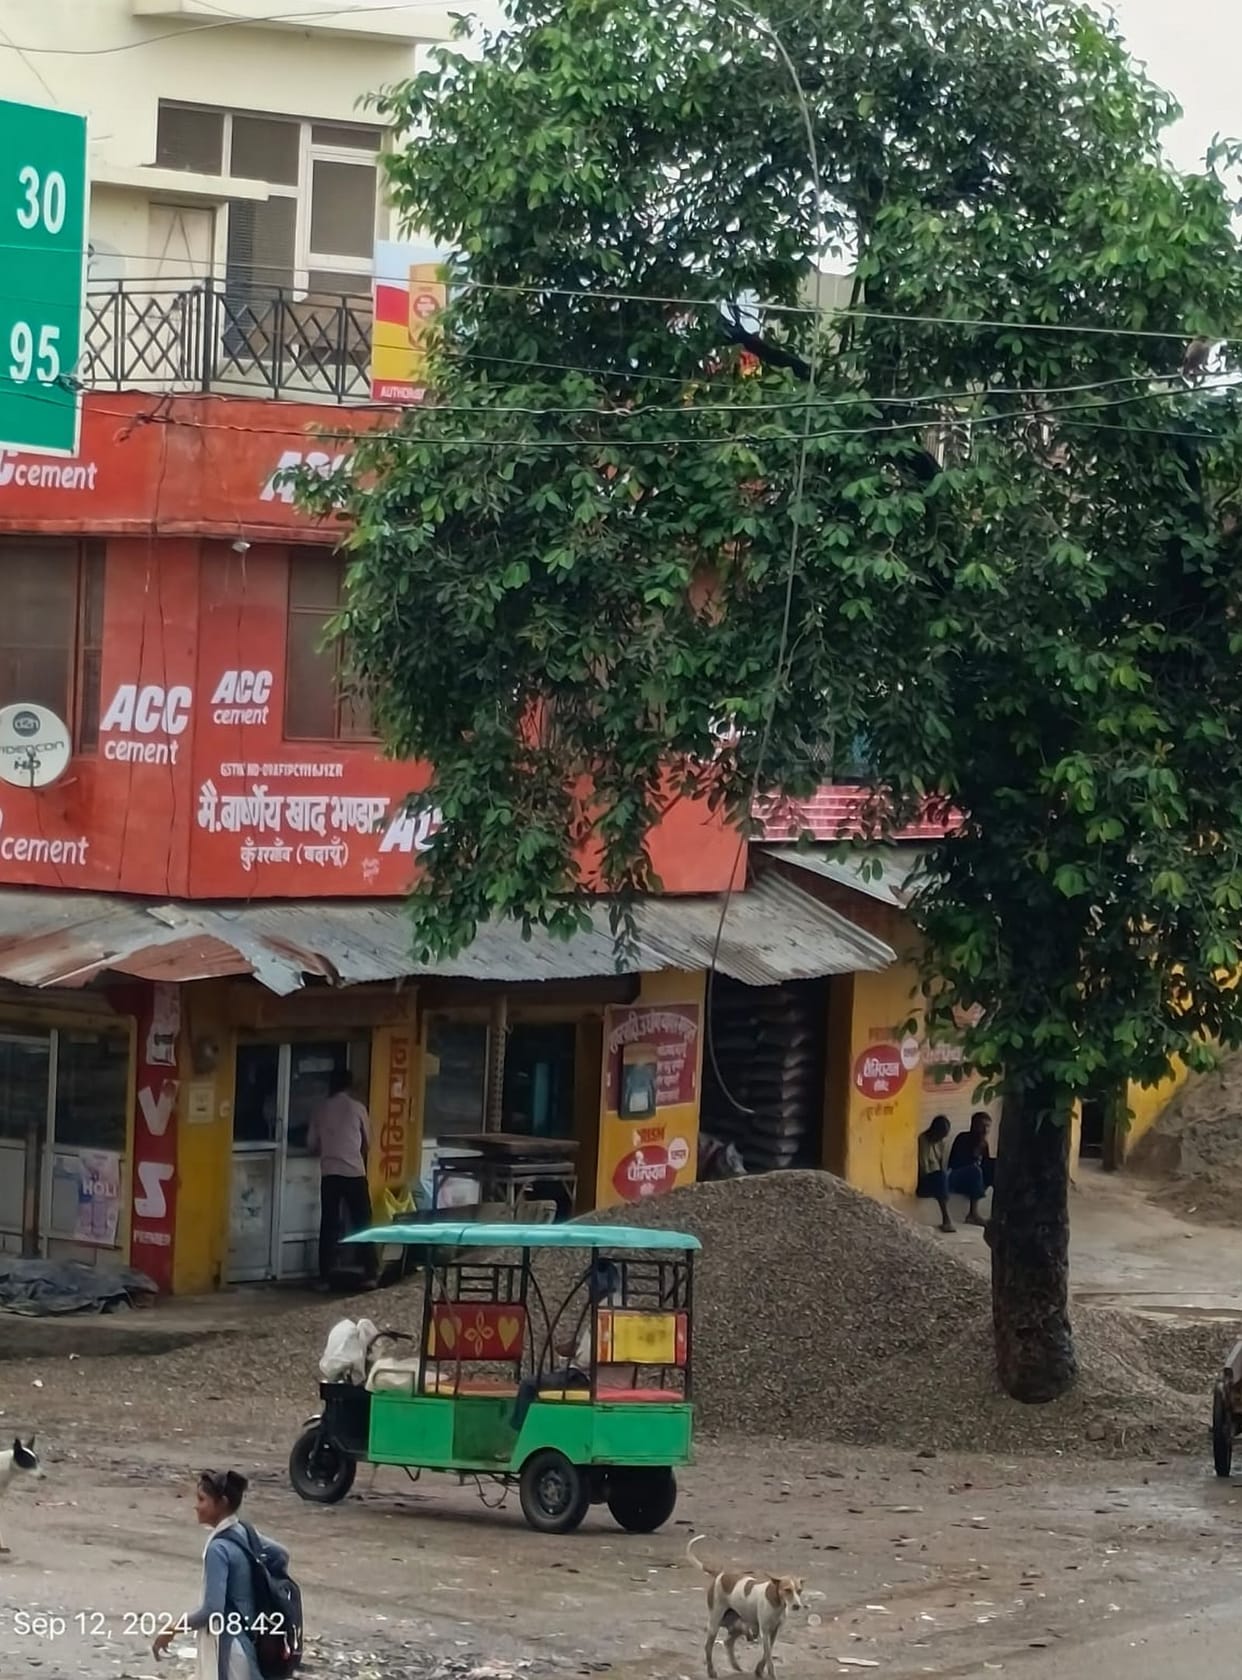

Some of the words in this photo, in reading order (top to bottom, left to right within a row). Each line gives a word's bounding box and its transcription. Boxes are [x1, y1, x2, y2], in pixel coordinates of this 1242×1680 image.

[17, 165, 66, 234] 30
[9, 321, 61, 387] 95
[15, 462, 98, 490] cement
[210, 670, 273, 704] ACC
[100, 685, 193, 735] ACC
[213, 705, 269, 725] cement
[104, 740, 179, 765] cement
[286, 796, 329, 836] खाद
[1, 836, 89, 865] cement
